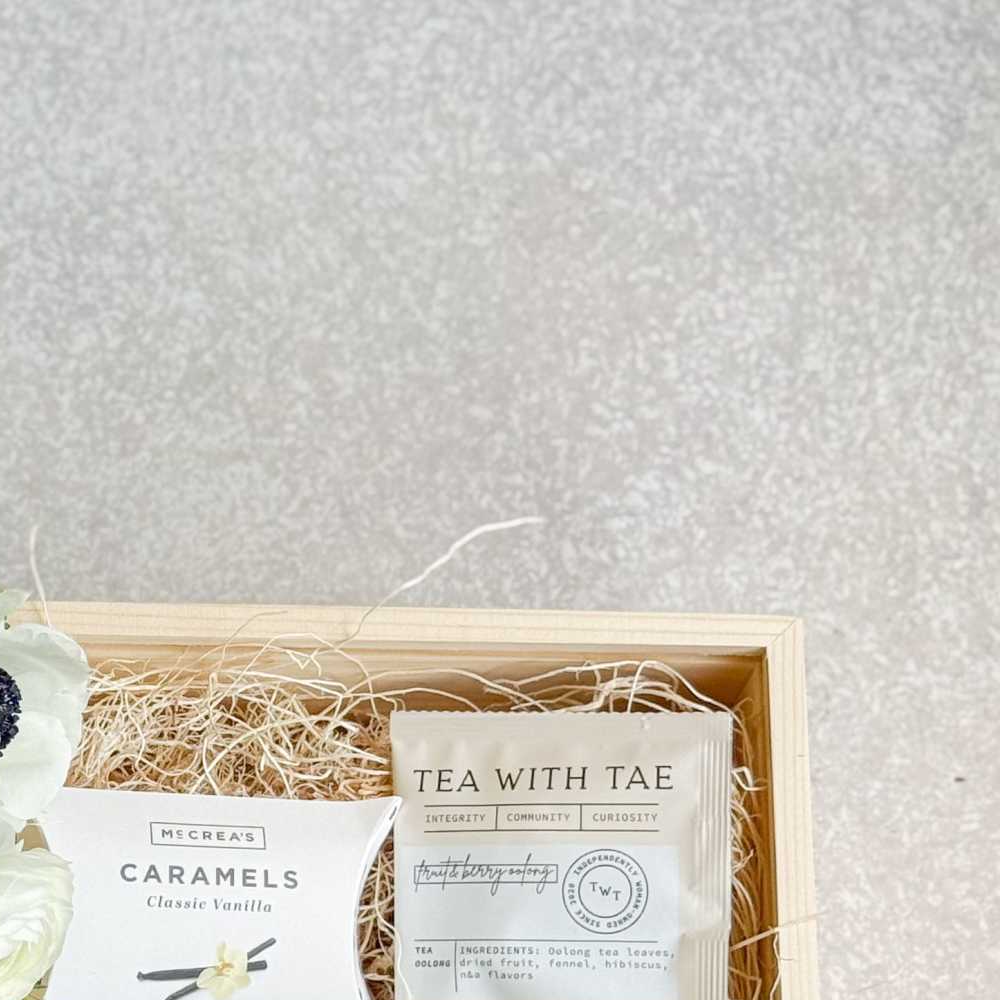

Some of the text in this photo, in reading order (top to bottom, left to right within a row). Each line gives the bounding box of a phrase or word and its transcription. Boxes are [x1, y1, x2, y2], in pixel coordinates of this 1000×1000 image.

[414, 765, 674, 792] TEA WITH TAE
[425, 812, 486, 823] INTEGRITY
[506, 812, 571, 822] COMMUNITY
[592, 812, 659, 823] CURIOSITY
[120, 863, 299, 890] CARAMELS
[146, 895, 272, 913] Classic Vanilla
[415, 946, 433, 954] TEA
[460, 946, 540, 955] INGREDIENTS:
[547, 946, 591, 957] Oolong
[599, 948, 619, 957] tea
[414, 959, 451, 968] OOLONG
[459, 959, 493, 967] dried
[500, 959, 540, 969] fruit,
[605, 960, 668, 971] hibiscus,
[488, 970, 534, 980] flavors
